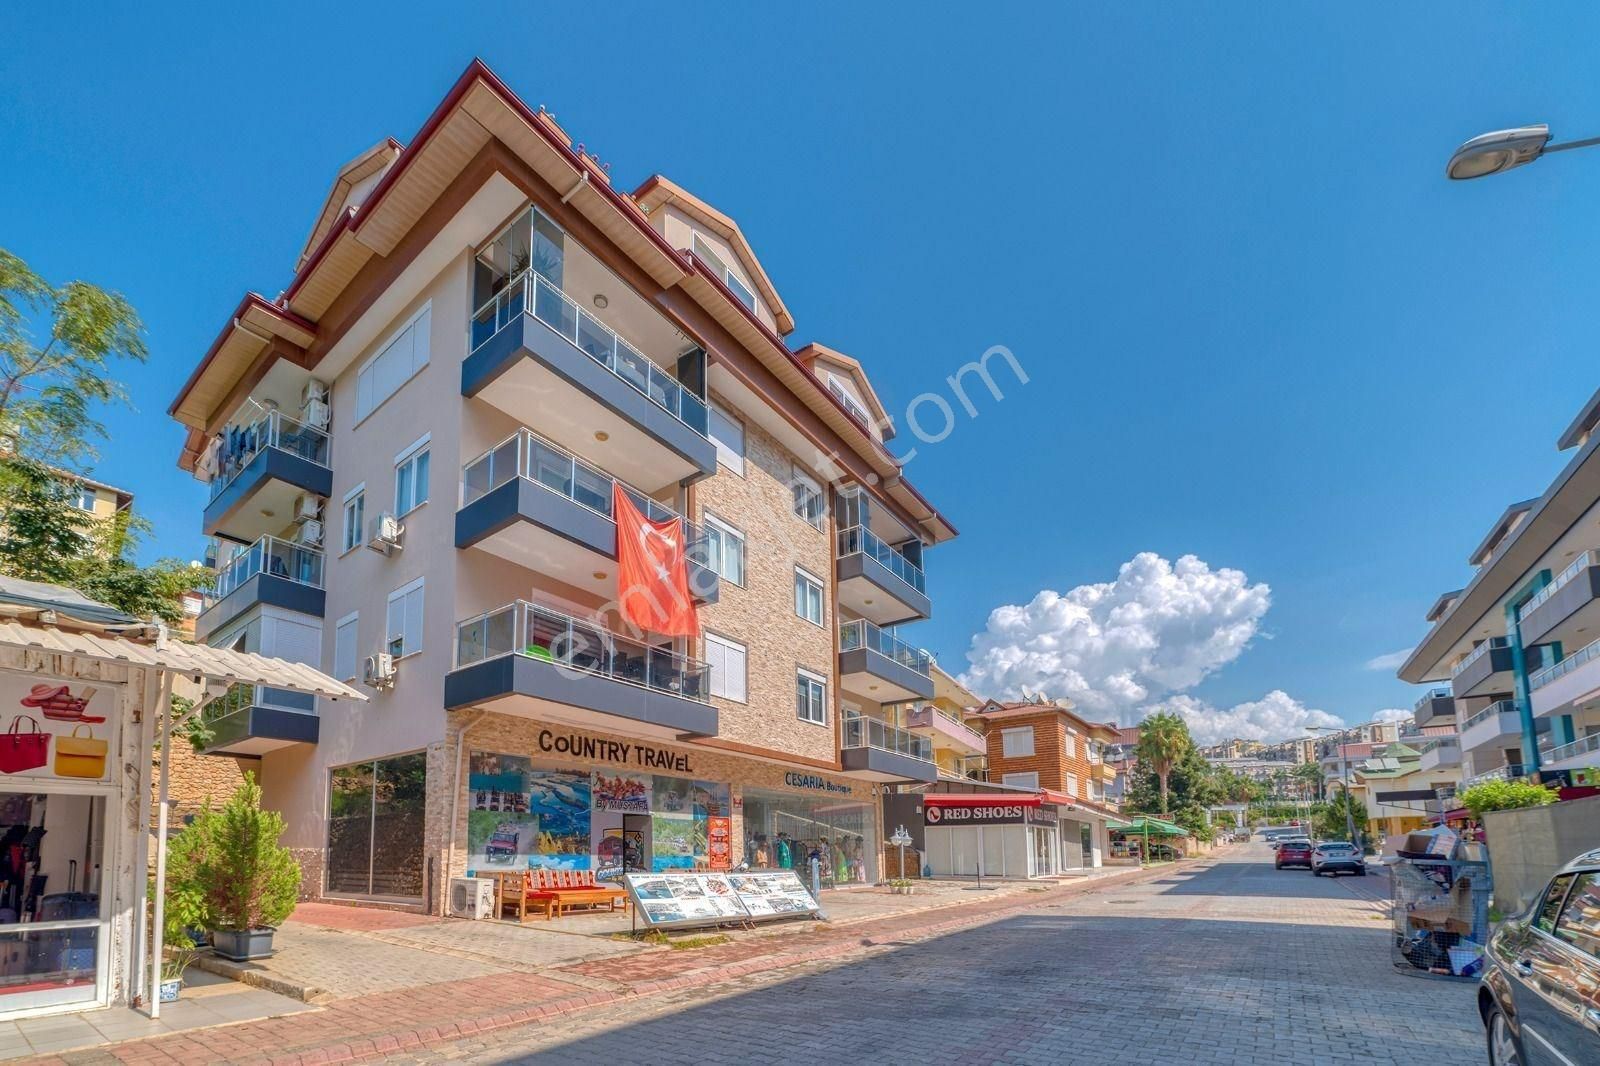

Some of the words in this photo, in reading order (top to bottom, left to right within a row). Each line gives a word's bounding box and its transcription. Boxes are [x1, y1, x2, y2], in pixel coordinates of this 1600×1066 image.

[538, 729, 630, 763] COUNTRY
[785, 771, 825, 790] CESARIA
[826, 781, 852, 794] Boutique
[943, 808, 971, 820] RED
[973, 806, 1022, 819] SHOES
